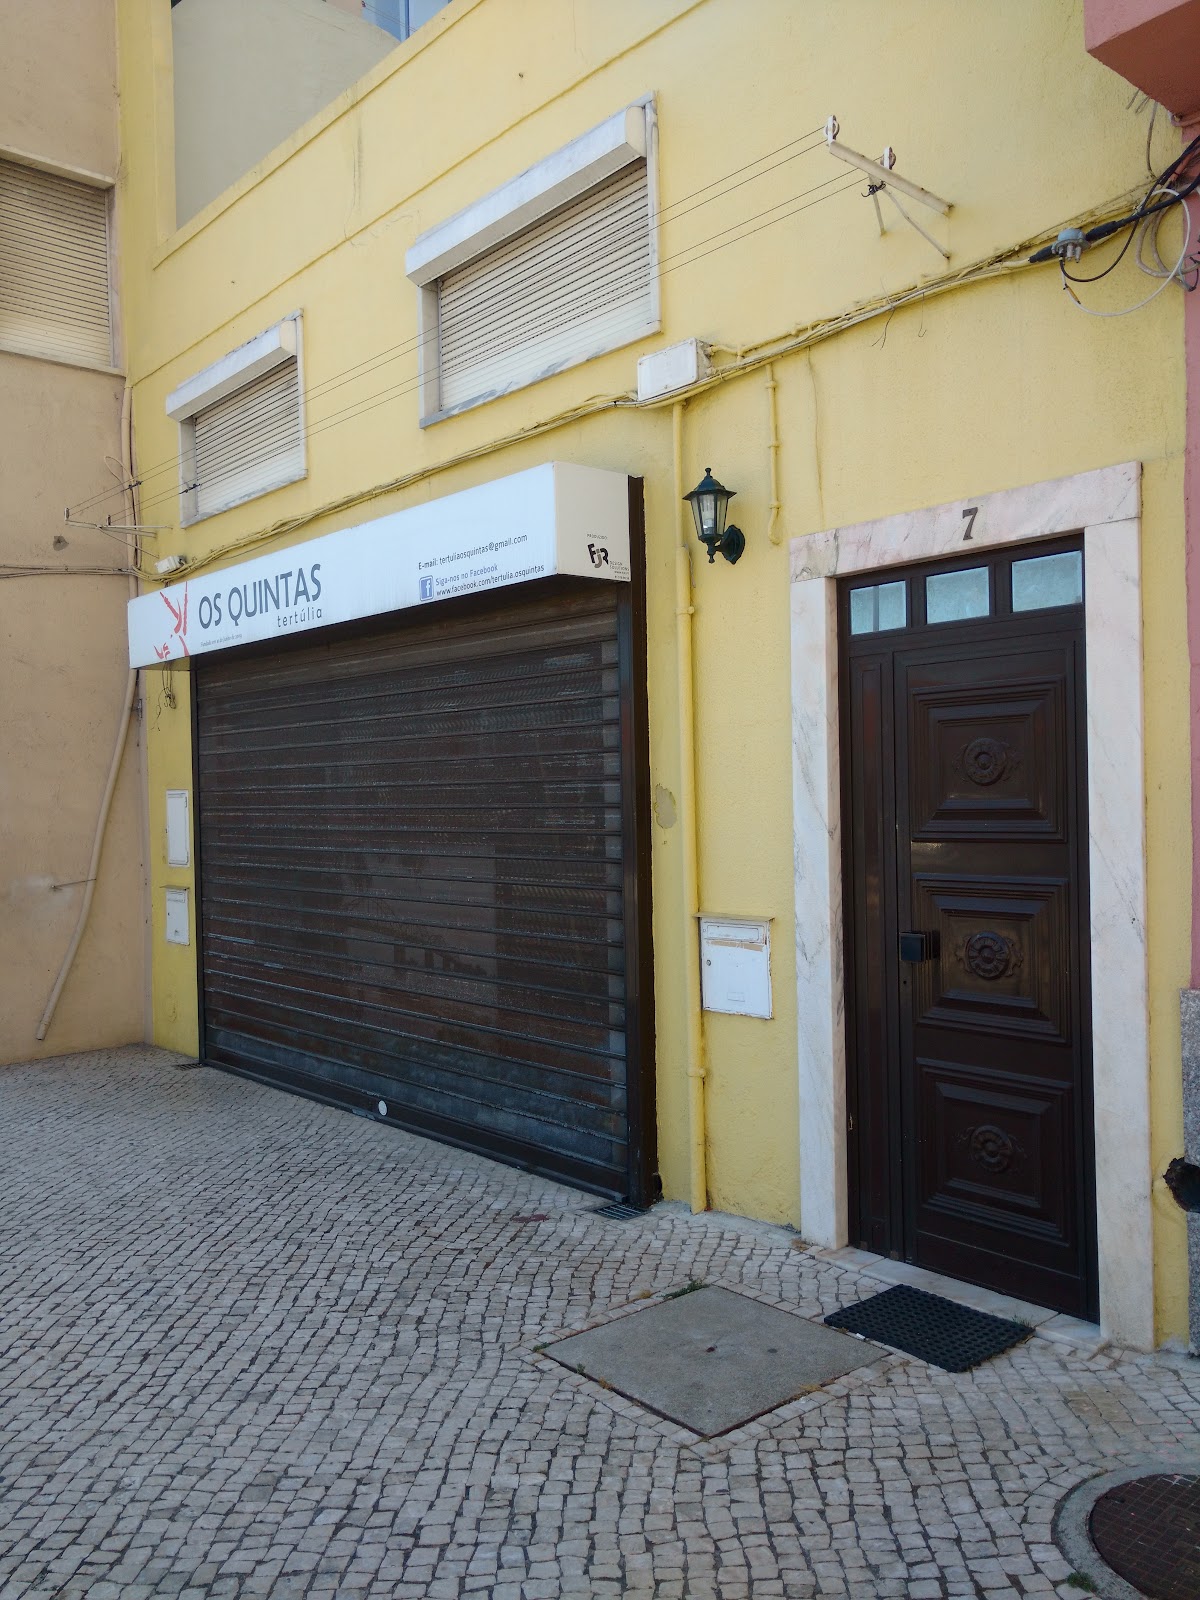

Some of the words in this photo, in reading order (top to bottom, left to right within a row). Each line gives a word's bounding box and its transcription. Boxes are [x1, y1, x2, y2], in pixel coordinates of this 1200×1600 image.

[962, 506, 978, 541] 7
[418, 557, 439, 571] E-mail:
[439, 534, 528, 566] tertuliaosquintas@gmail.com
[435, 573, 460, 587] Siga-nos
[461, 571, 469, 580] no
[469, 562, 498, 578] Facebook
[436, 564, 545, 597] www.facebook.com/tertulia.osquintas
[198, 592, 223, 630] OS
[228, 563, 322, 627] QUINTAS
[277, 606, 323, 629] tertúlia
